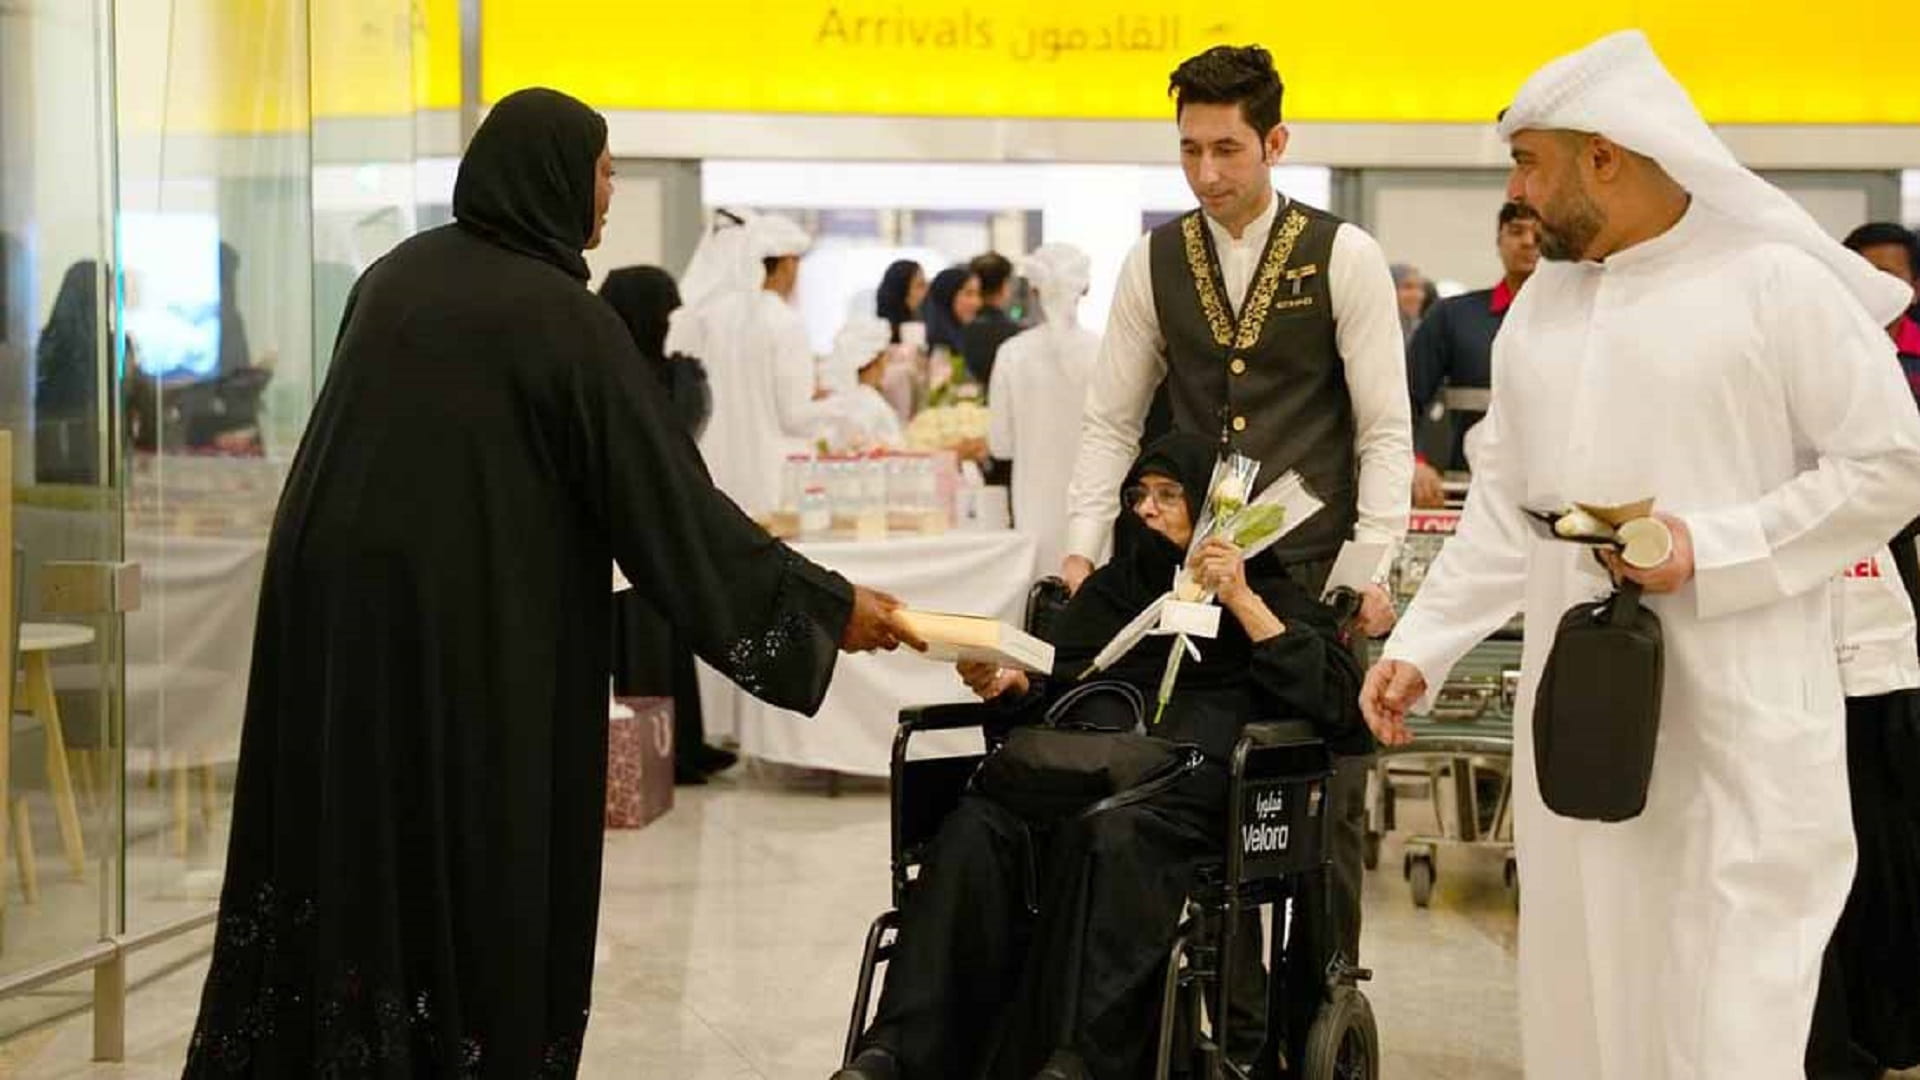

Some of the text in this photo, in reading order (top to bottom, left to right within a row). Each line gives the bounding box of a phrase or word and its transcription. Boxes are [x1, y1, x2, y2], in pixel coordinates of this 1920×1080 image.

[815, 8, 994, 52] Arrivals
[1009, 13, 1182, 61] القادمون
[1242, 823, 1289, 853] Velora
